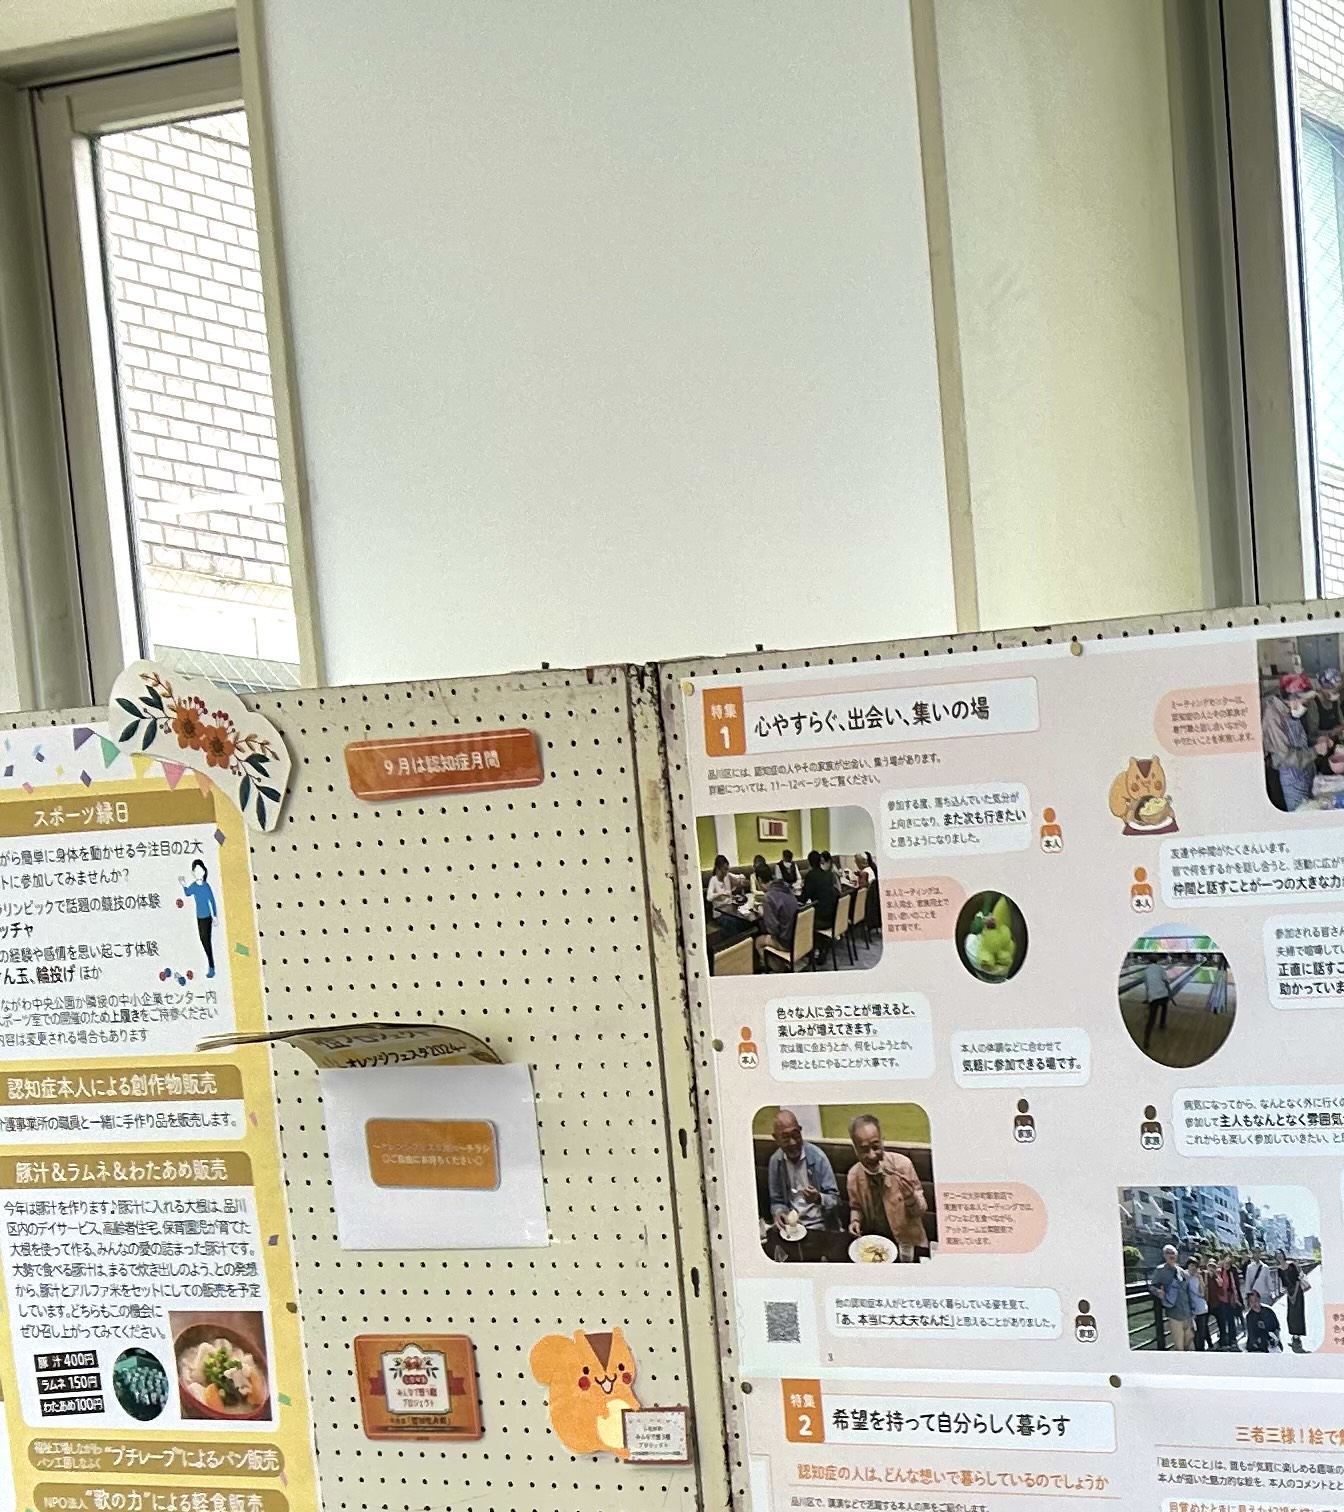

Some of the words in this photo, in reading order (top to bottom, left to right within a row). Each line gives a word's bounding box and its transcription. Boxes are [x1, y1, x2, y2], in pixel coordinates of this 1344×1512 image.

[710, 703, 738, 722] 特集
[754, 696, 991, 738] 心やすらぐ、出会い、集いの場
[719, 726, 731, 749] 1
[383, 749, 501, 775] 9月は認知症月間
[34, 802, 129, 827] スポーツ縁日
[7, 1071, 218, 1100] 認知症本人による創作物販売
[790, 1394, 816, 1409] 特集
[799, 1414, 813, 1436] 2
[832, 1408, 1071, 1438] 希望を持って自分らしく暮らす
